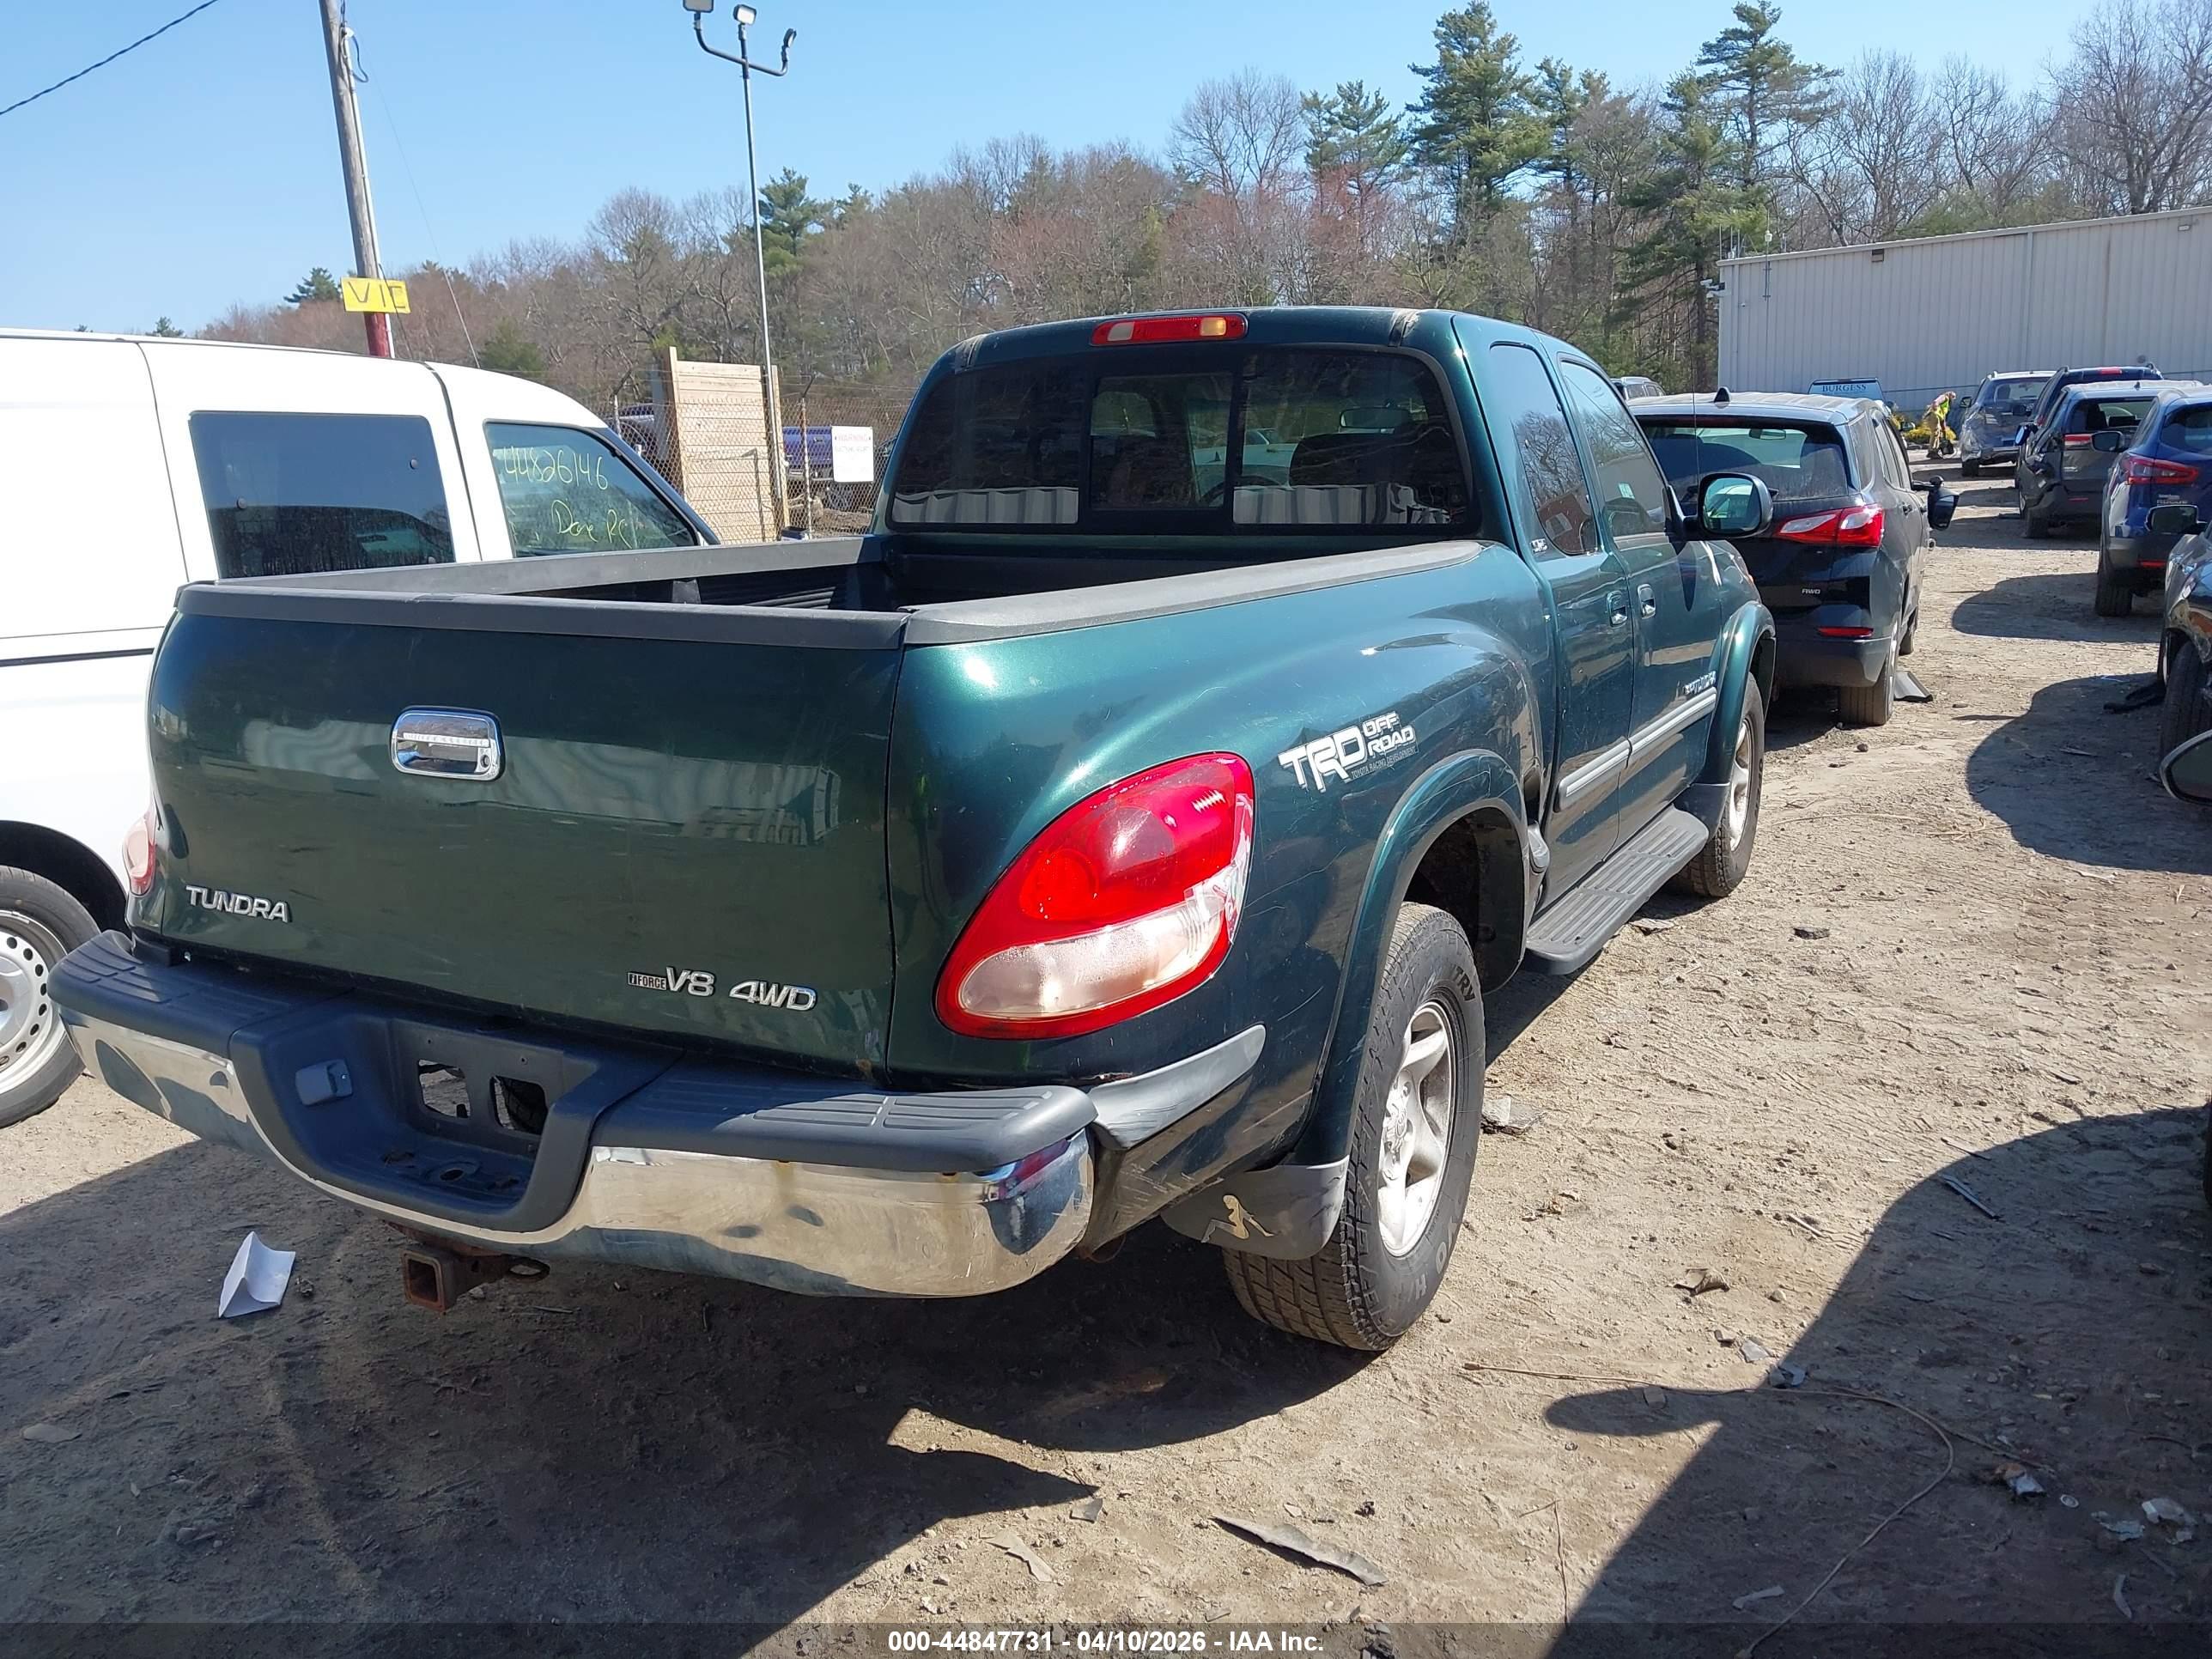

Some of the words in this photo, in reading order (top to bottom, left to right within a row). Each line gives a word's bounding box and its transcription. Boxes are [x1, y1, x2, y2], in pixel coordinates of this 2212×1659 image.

[1822, 384, 1867, 392] BURGESS
[502, 445, 609, 490] 44826146
[1361, 711, 1400, 739] OFF
[1367, 725, 1417, 758] ROAD
[1278, 725, 1368, 793] TRD
[1351, 766, 1370, 780] TOYOTA
[185, 884, 293, 923] TUNDRA
[665, 966, 715, 997] V8
[728, 980, 817, 1011] 4WD
